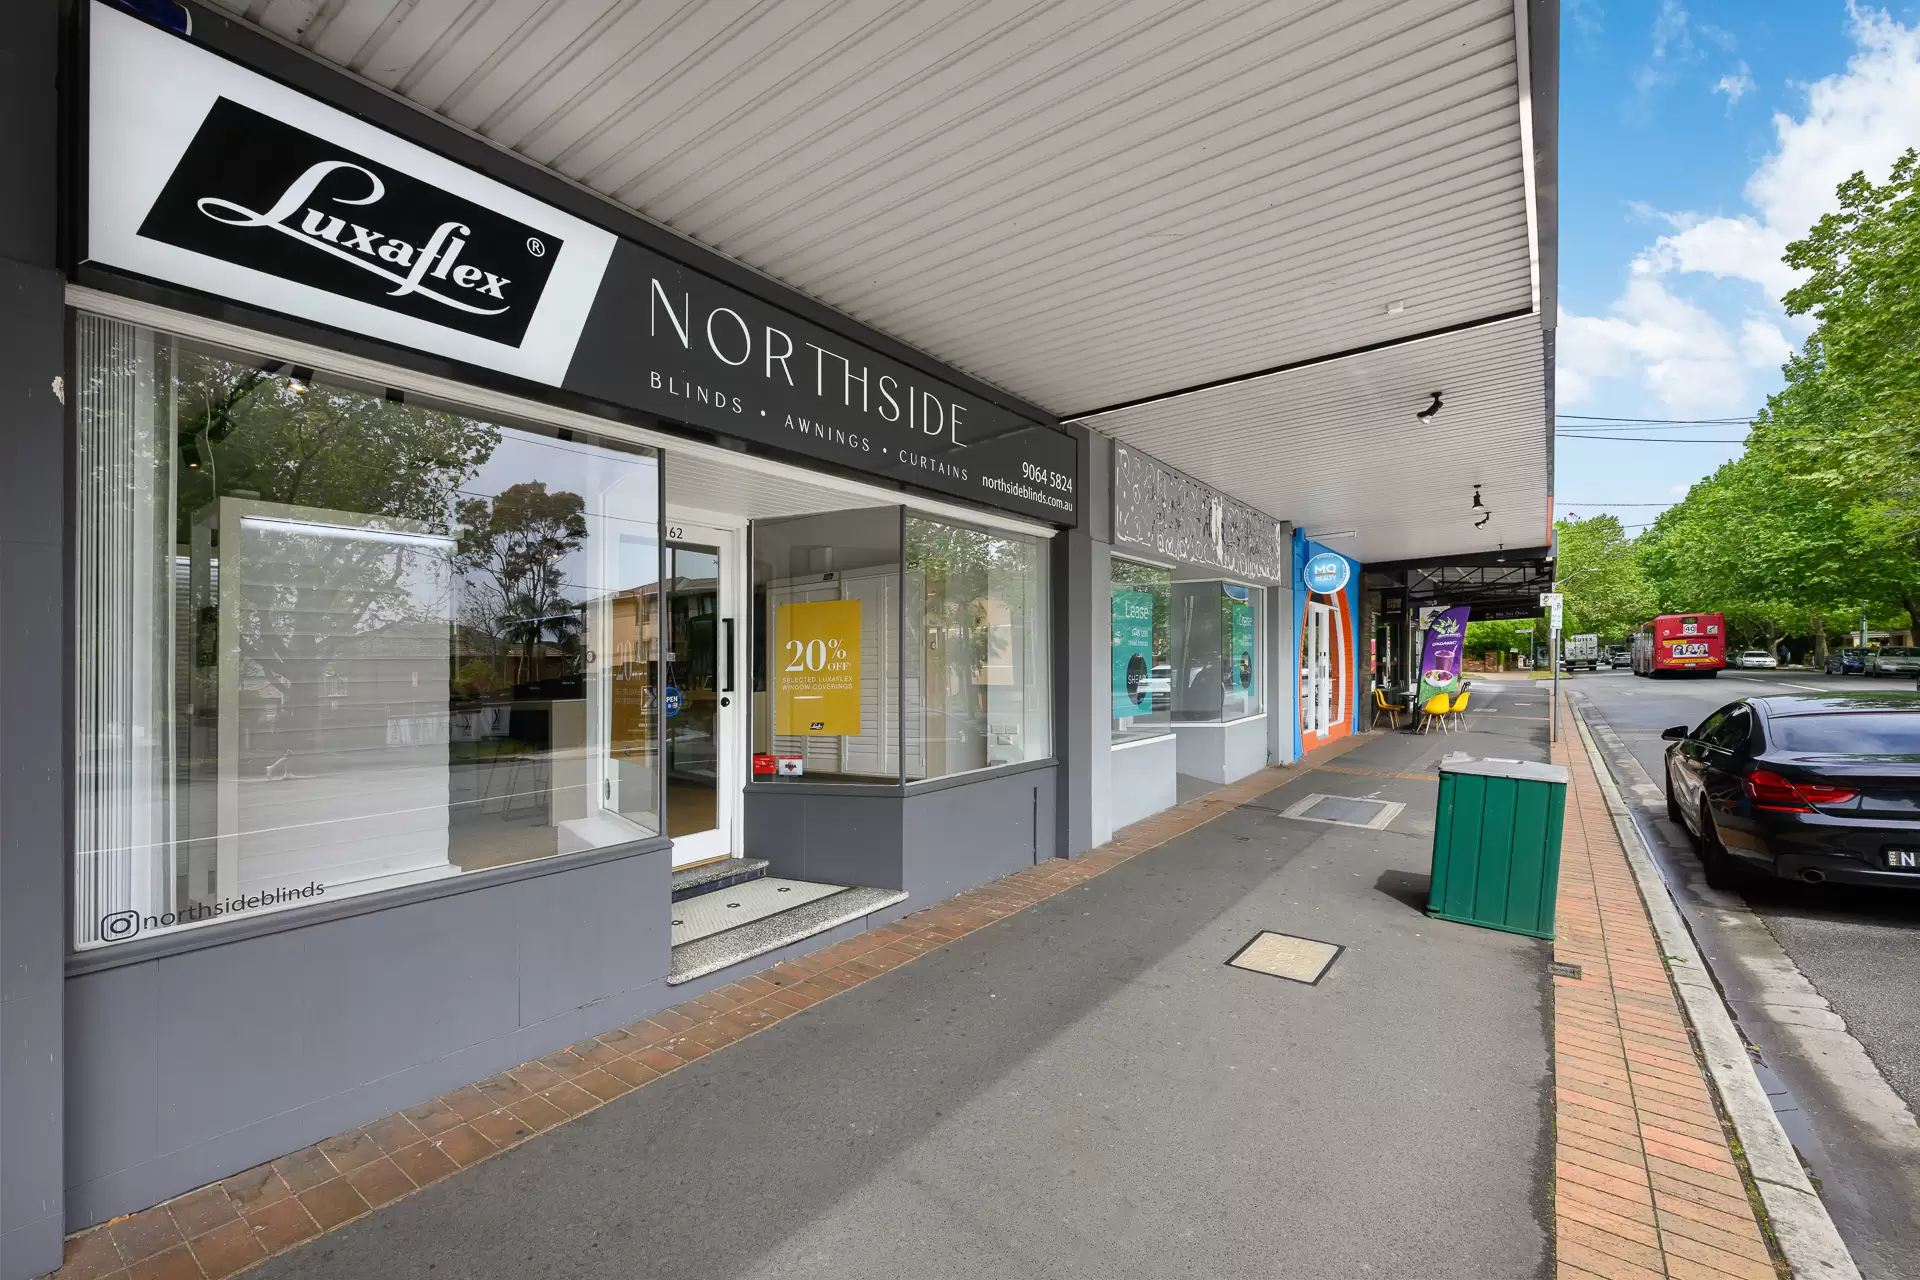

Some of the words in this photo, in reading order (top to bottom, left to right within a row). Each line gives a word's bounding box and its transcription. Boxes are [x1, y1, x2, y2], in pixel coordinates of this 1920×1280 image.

[197, 160, 511, 316] Luxaflex
[650, 277, 968, 448] NORTHSIDE
[650, 370, 743, 414] BLINDS
[784, 413, 871, 453] AWNINGS
[899, 449, 969, 481] CURTAINS
[982, 475, 1073, 512] northsideblinds.com.au
[1022, 461, 1048, 485] 9064
[1049, 471, 1073, 494] 5824
[1125, 600, 1149, 620] Lease
[784, 638, 847, 672] 20%
[782, 676, 817, 684] SELECTED
[818, 675, 853, 683] LUXAFLEX
[666, 695, 678, 703] PEN
[143, 881, 325, 930] northsideblinds
